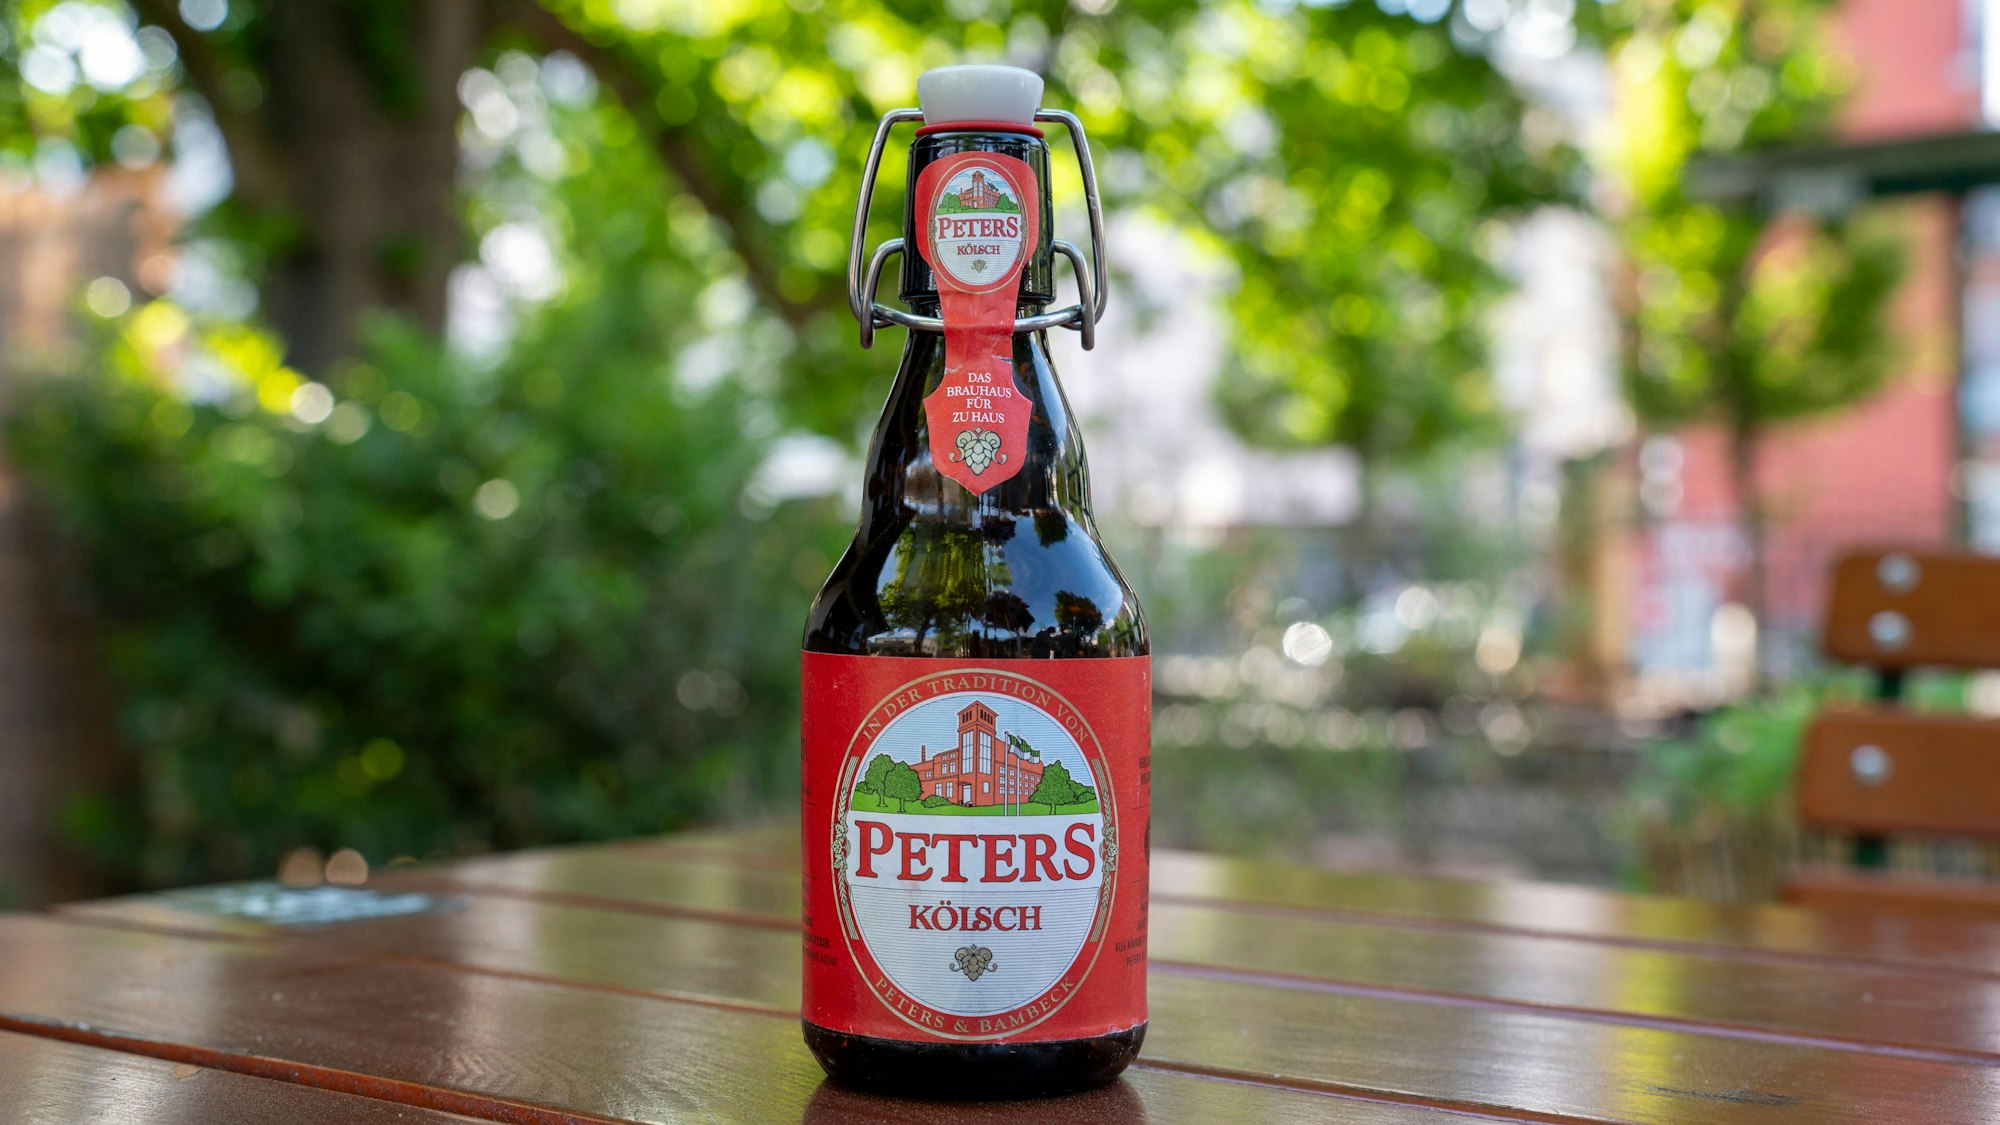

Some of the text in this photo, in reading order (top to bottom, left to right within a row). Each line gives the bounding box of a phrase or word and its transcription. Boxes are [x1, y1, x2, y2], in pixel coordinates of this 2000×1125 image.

[938, 216, 1019, 239] PETERS
[957, 244, 1000, 256] KÖLSCH
[968, 372, 991, 383] DAS
[946, 386, 1012, 398] BRAUHAUS
[966, 396, 992, 409] FÜR
[952, 411, 1005, 423] ZU HAUS
[862, 675, 1088, 742] IN DER TRADITION VON
[855, 819, 1096, 883] PETERS
[908, 900, 1042, 931] KÖLSCH
[875, 976, 1075, 1033] PETERS & BAMBECK
